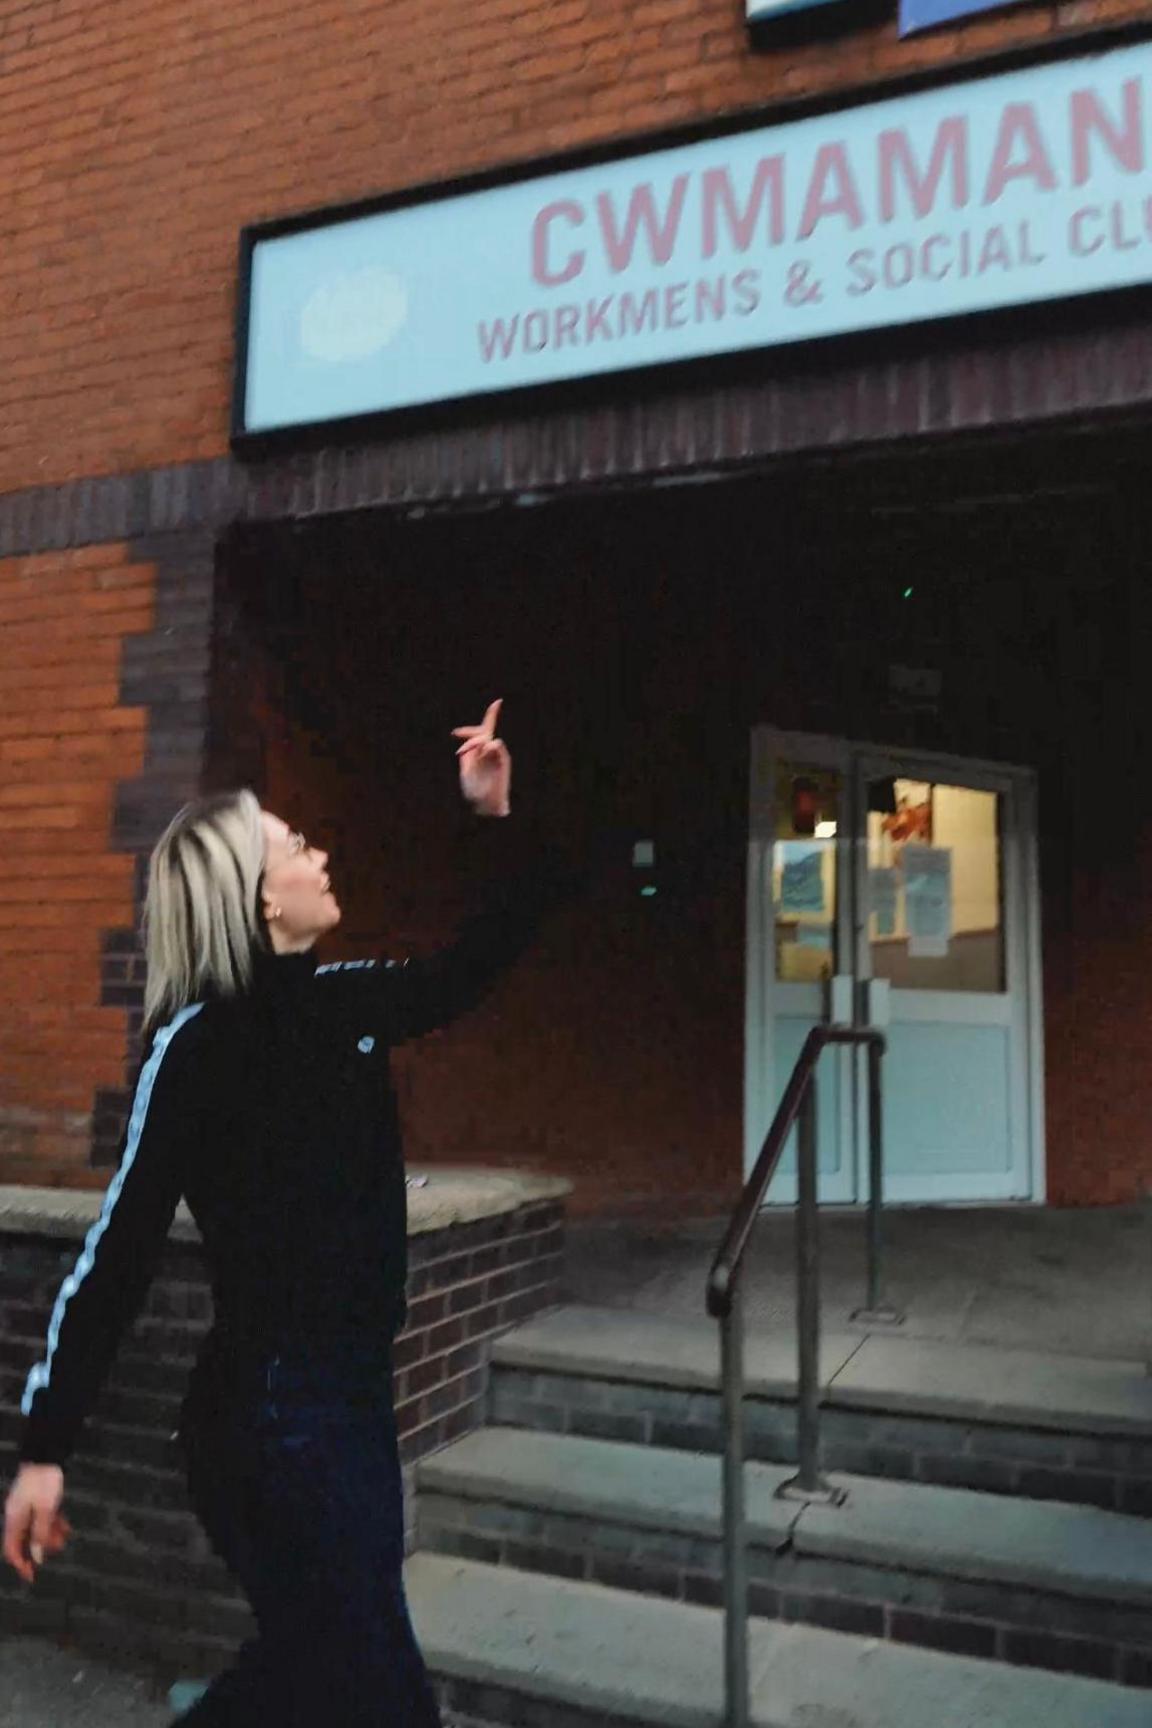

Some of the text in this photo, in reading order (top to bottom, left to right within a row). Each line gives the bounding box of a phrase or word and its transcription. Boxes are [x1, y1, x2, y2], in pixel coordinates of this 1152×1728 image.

[530, 77, 1146, 286] CWMAMAN
[477, 194, 1152, 363] WORKMENS & SOCIAL CL
